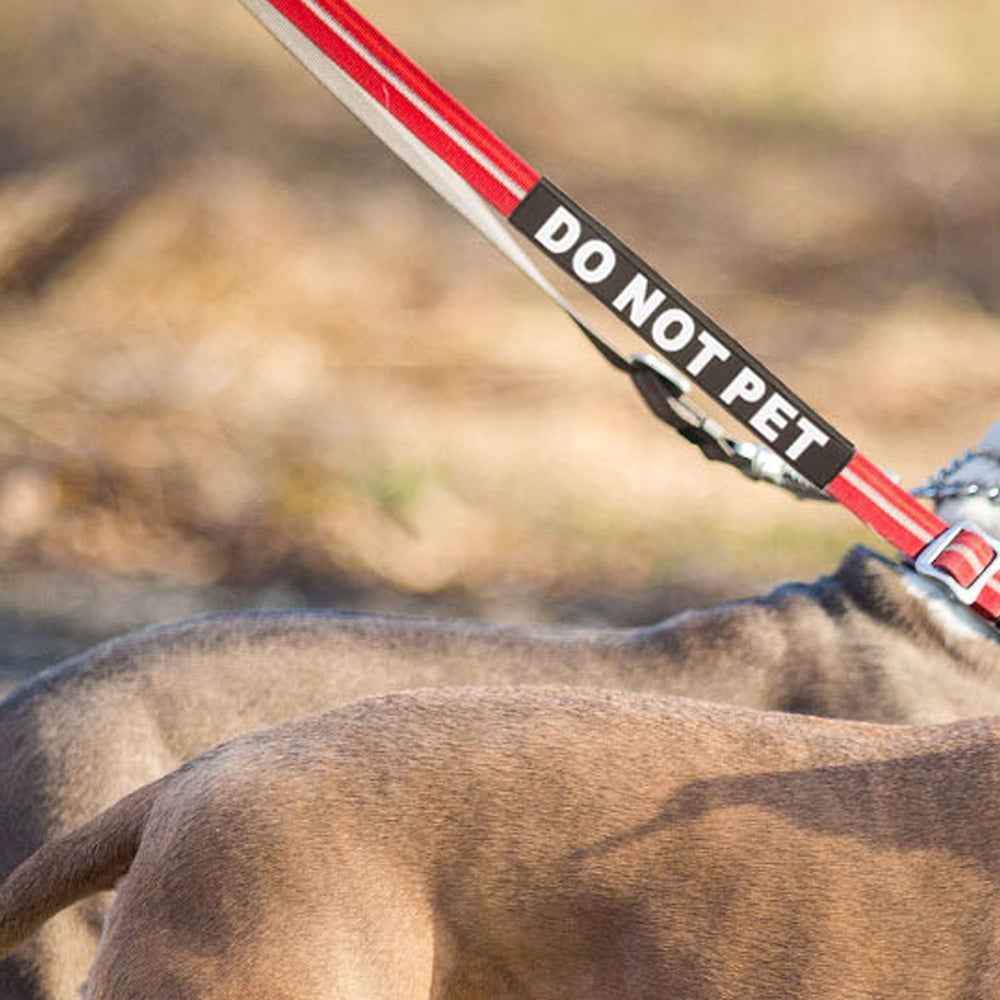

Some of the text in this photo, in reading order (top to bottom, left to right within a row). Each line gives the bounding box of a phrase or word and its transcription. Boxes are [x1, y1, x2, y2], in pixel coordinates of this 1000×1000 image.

[534, 205, 829, 460] DO NOT PET
